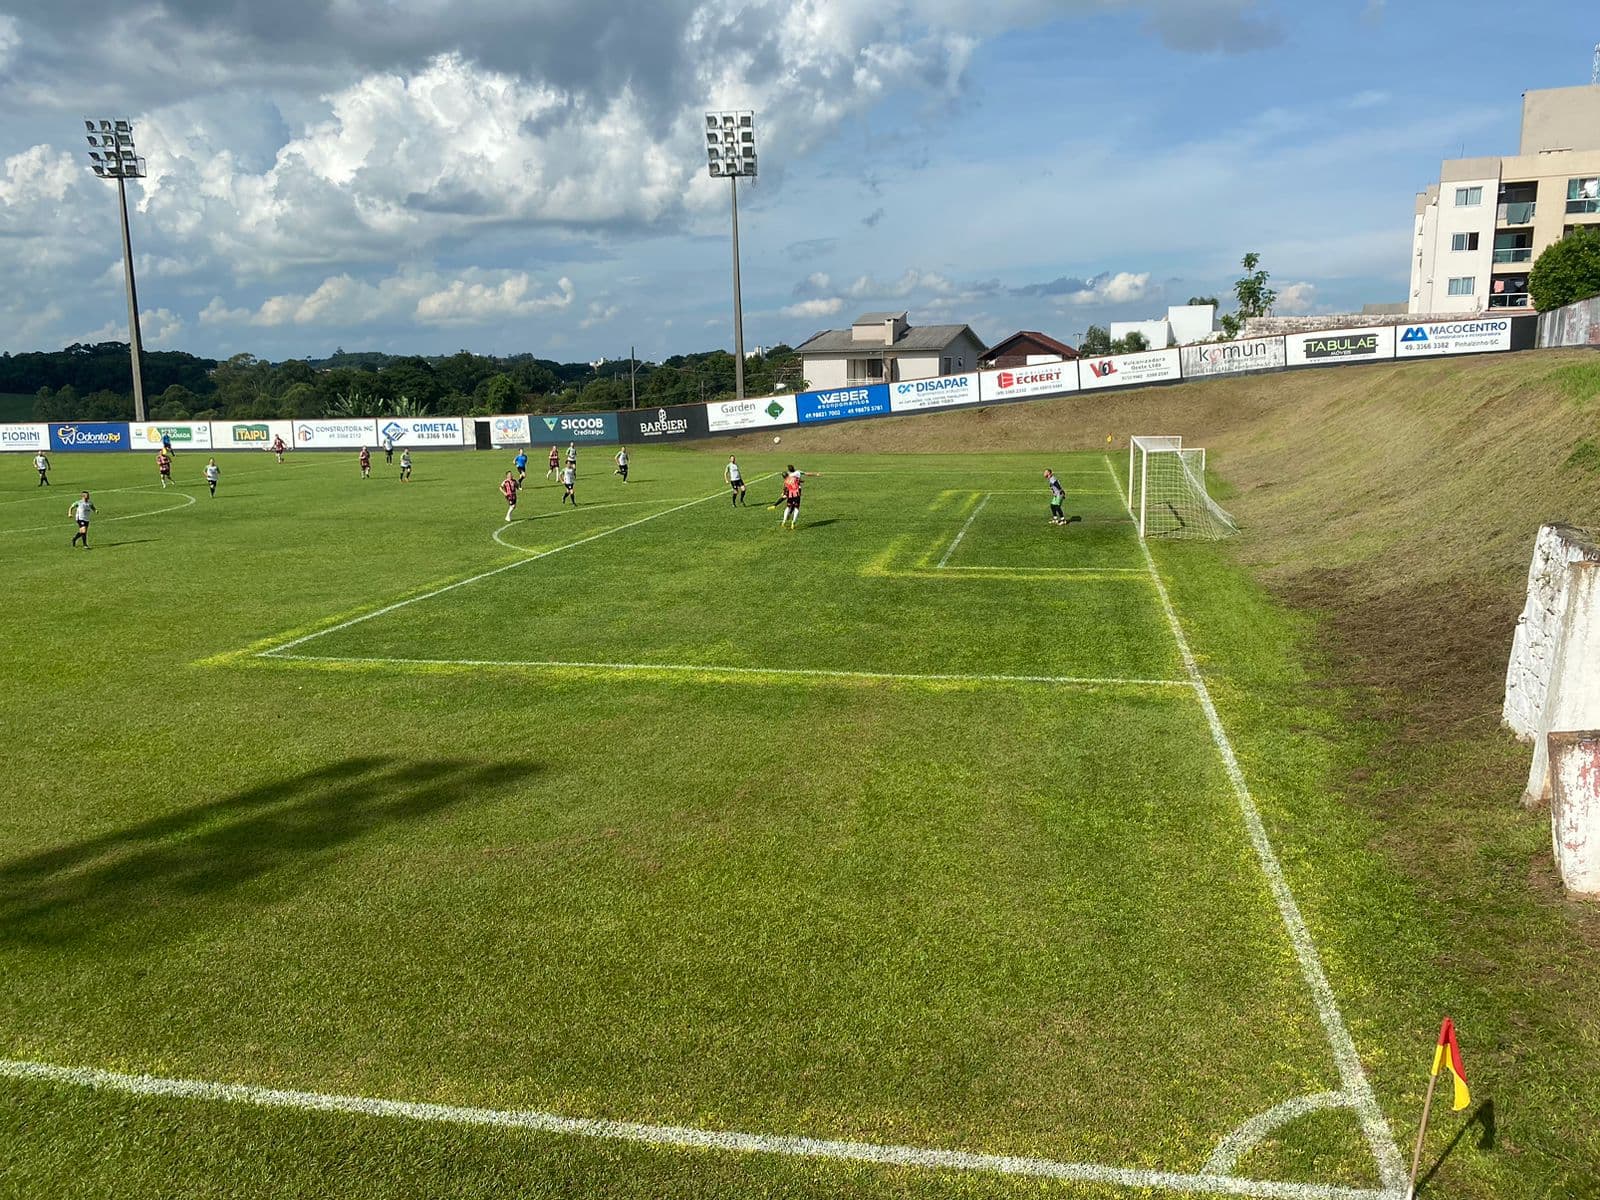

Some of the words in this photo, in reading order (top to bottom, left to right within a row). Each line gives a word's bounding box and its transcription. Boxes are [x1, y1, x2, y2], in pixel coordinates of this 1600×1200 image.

[1429, 321, 1508, 336] MACOCENTRO
[1304, 336, 1378, 353] TABULAE
[1199, 342, 1267, 363] komun
[1089, 359, 1118, 379] VOL
[916, 377, 968, 393] DISAPAR
[1016, 371, 1062, 385] ECKERT
[816, 389, 869, 404] WEBER
[720, 402, 756, 413] Garden
[412, 423, 459, 432] CIMETAL
[560, 418, 603, 430] SICOOB
[640, 419, 688, 433] BARBIERI
[2, 431, 40, 441] FIORINI
[235, 428, 267, 440] ITAIPU
